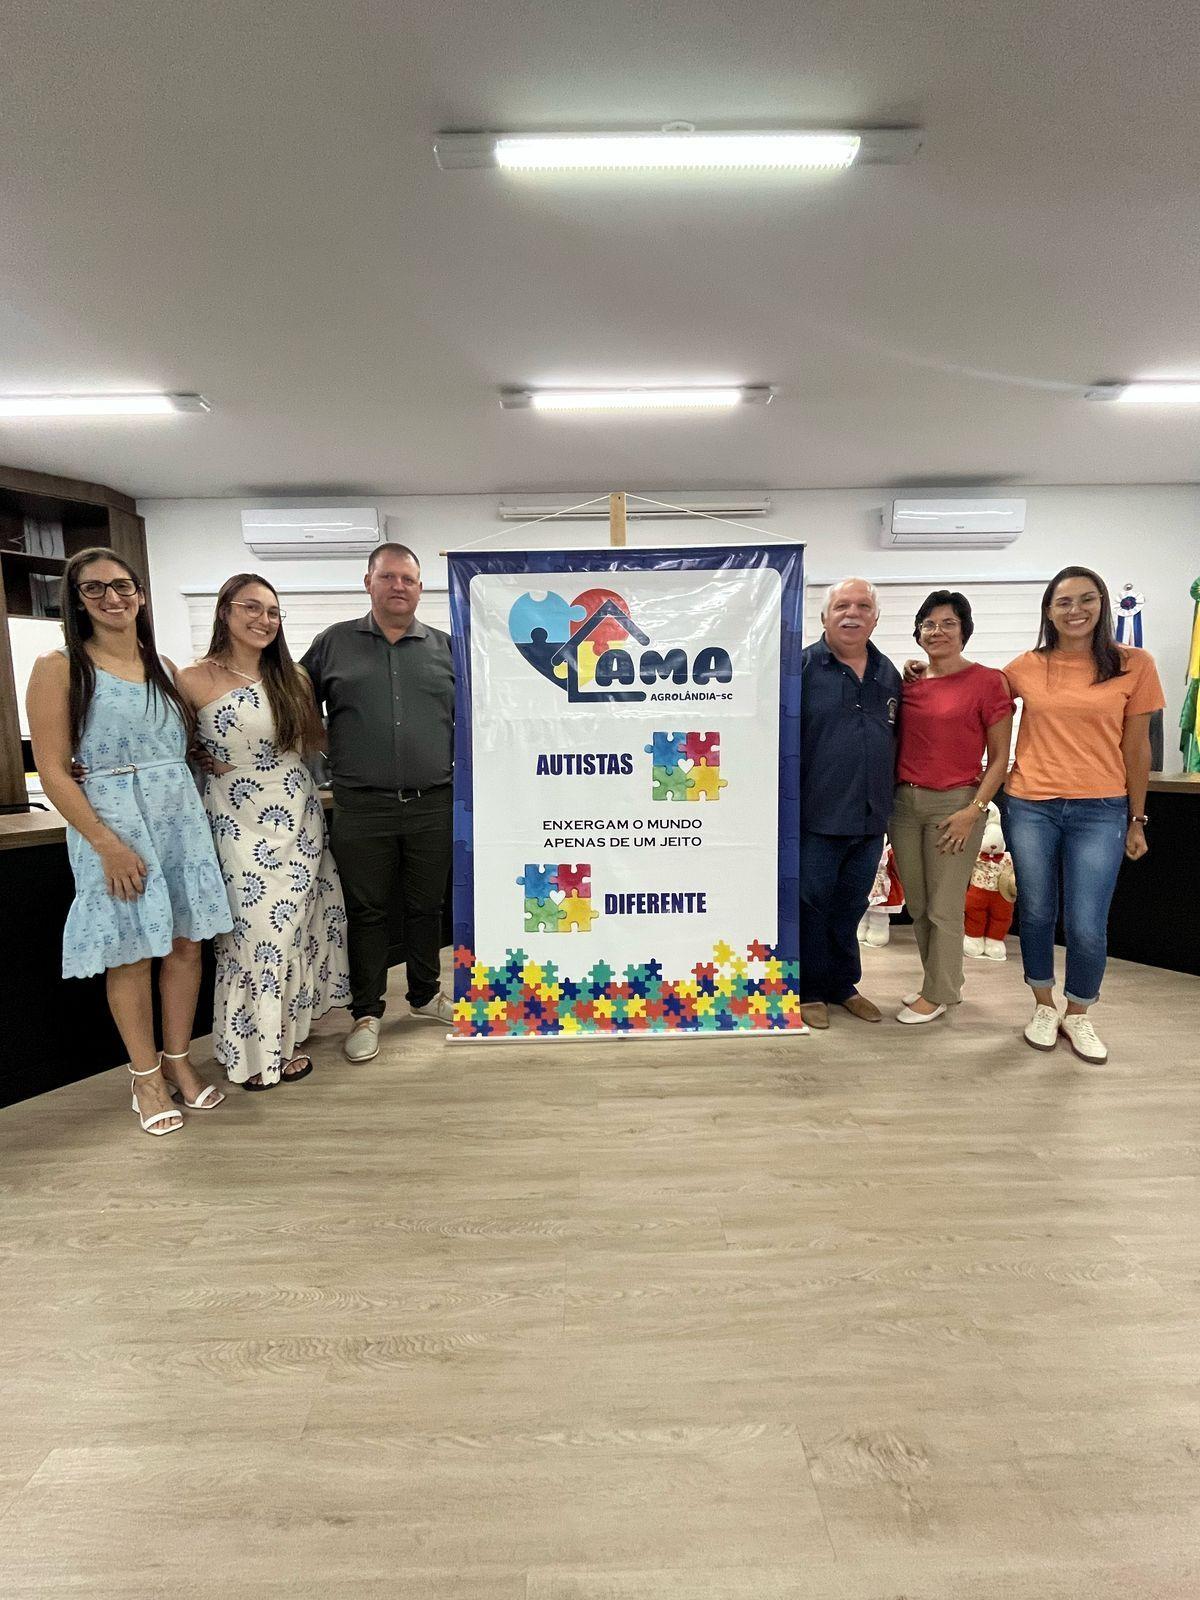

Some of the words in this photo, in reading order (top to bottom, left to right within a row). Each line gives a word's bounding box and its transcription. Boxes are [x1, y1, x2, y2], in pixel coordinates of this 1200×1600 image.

[595, 647, 733, 686] AMA
[536, 753, 633, 776] AUTISTAS
[543, 820, 629, 830] ENXERGAM
[633, 820, 644, 830] O
[647, 819, 703, 829] MUNDO
[543, 838, 606, 848] APENAS
[610, 838, 630, 847] DE
[633, 837, 656, 847] UM
[660, 836, 702, 847] JEITO
[604, 892, 707, 914] DIFERENTE
